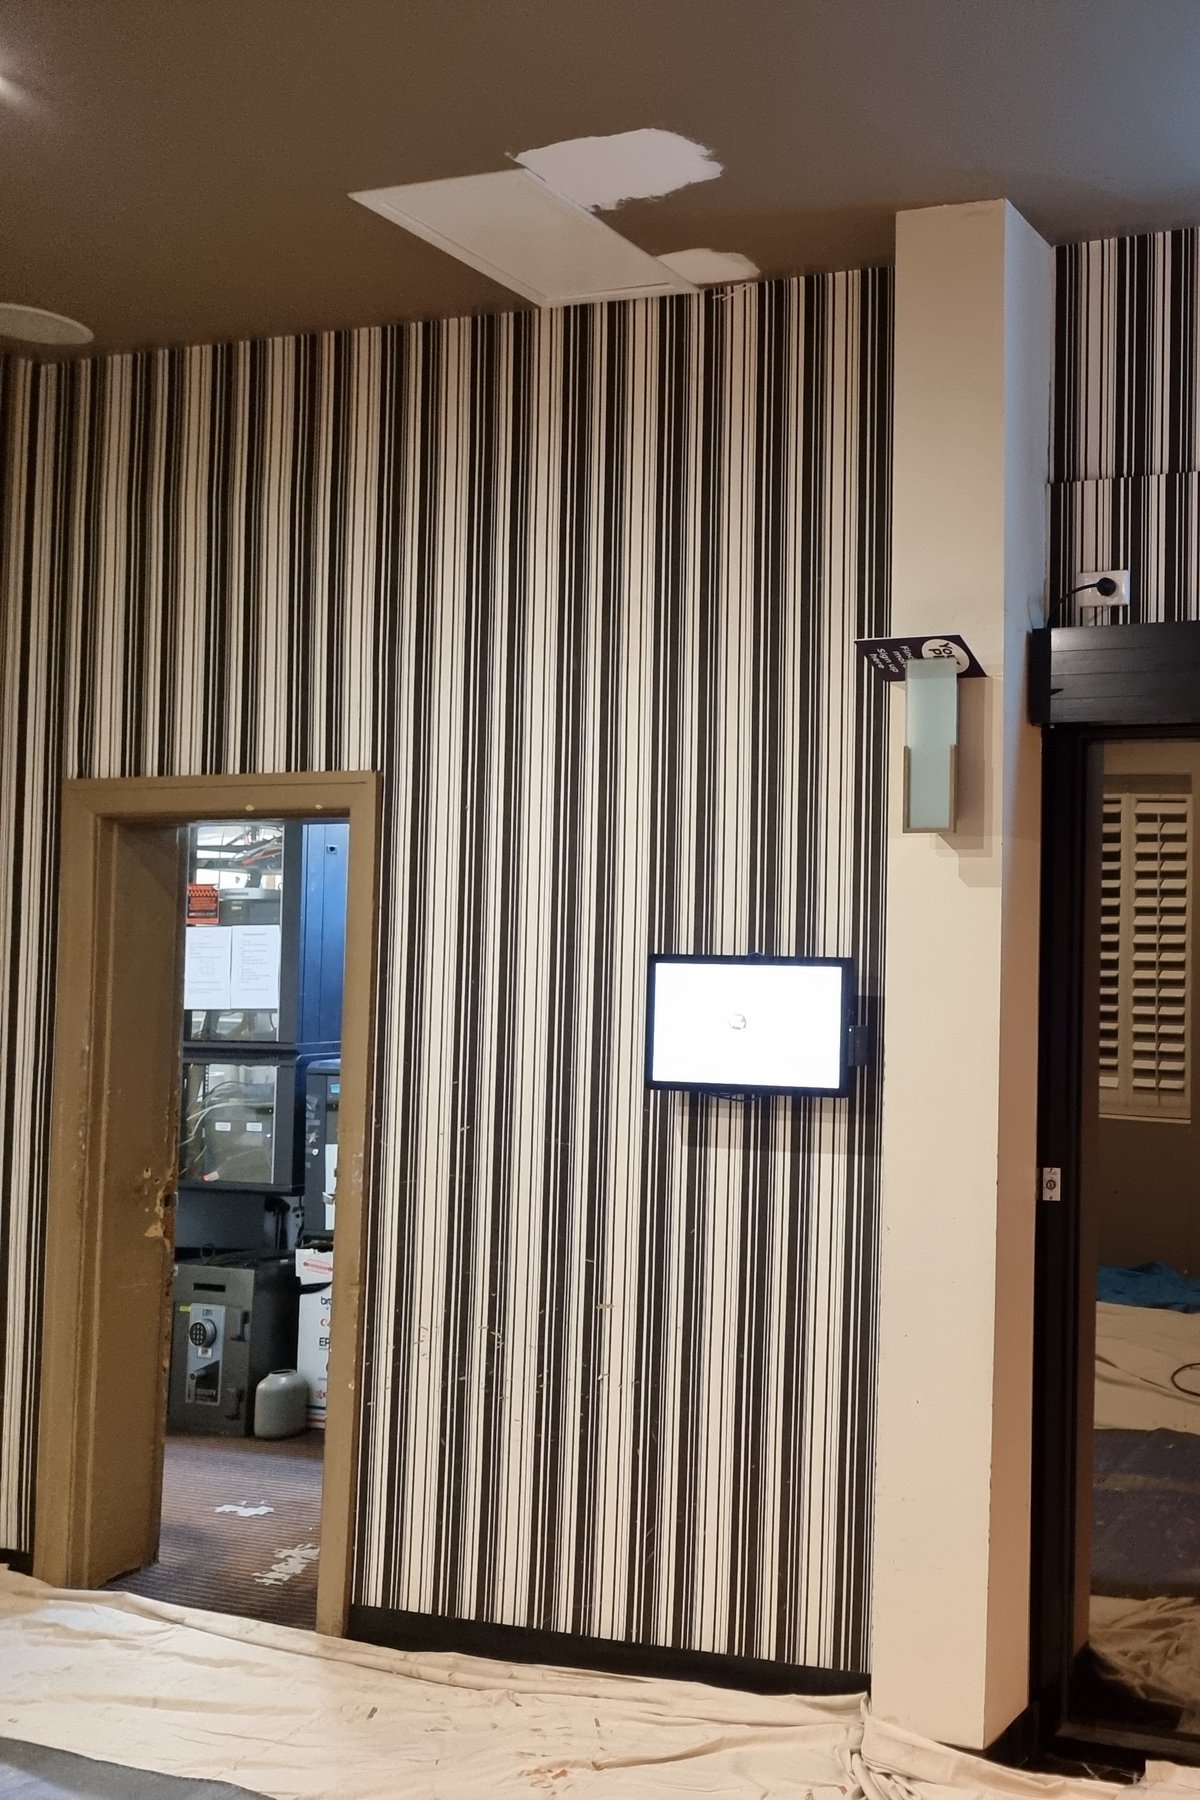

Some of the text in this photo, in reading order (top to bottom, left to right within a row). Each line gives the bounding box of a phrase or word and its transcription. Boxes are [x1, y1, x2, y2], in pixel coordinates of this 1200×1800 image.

[869, 653, 885, 669] here
[877, 648, 899, 673] Sign up
[893, 651, 906, 668] mor
[939, 643, 960, 665] Yo
